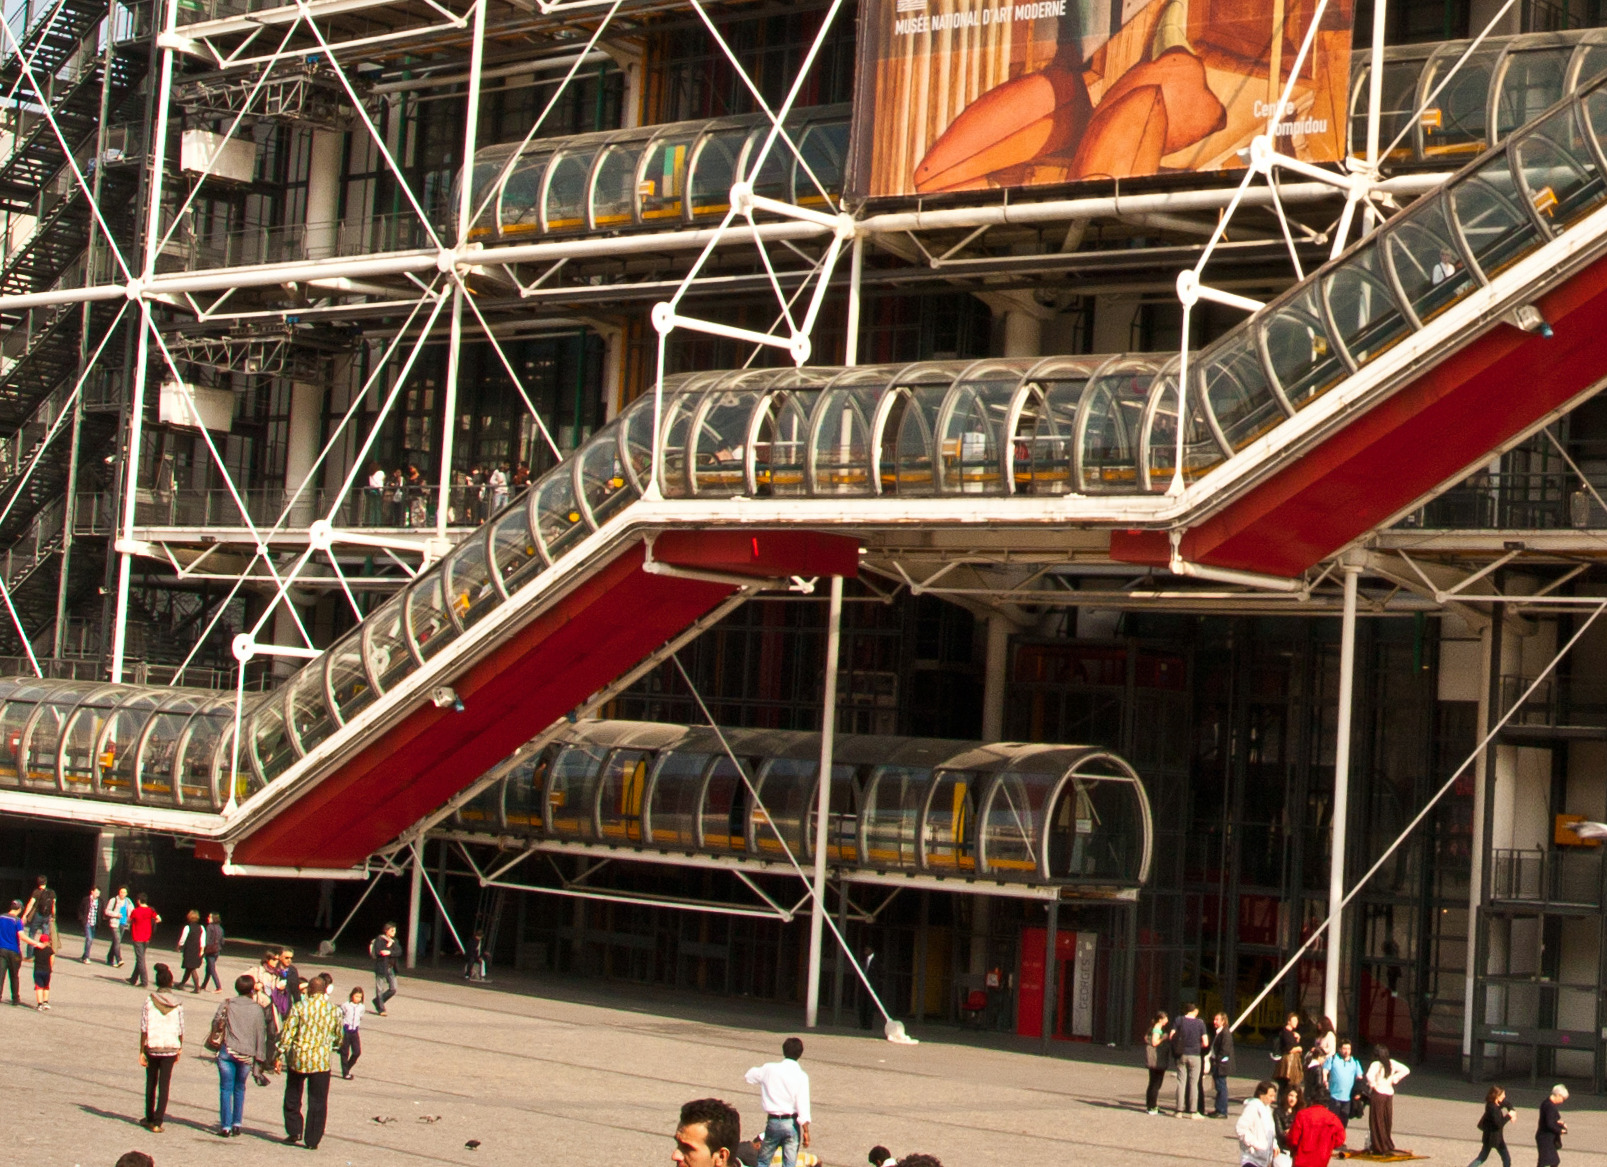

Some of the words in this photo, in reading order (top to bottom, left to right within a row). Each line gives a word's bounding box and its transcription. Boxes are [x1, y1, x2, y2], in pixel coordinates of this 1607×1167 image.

[895, 14, 930, 35] MUSÉE
[931, 9, 980, 31] NATIONAL
[982, 5, 1013, 25] D'ART
[1014, 0, 1067, 21] MODERNE
[1253, 99, 1294, 118] Cene
[1268, 115, 1327, 139] ompidou
